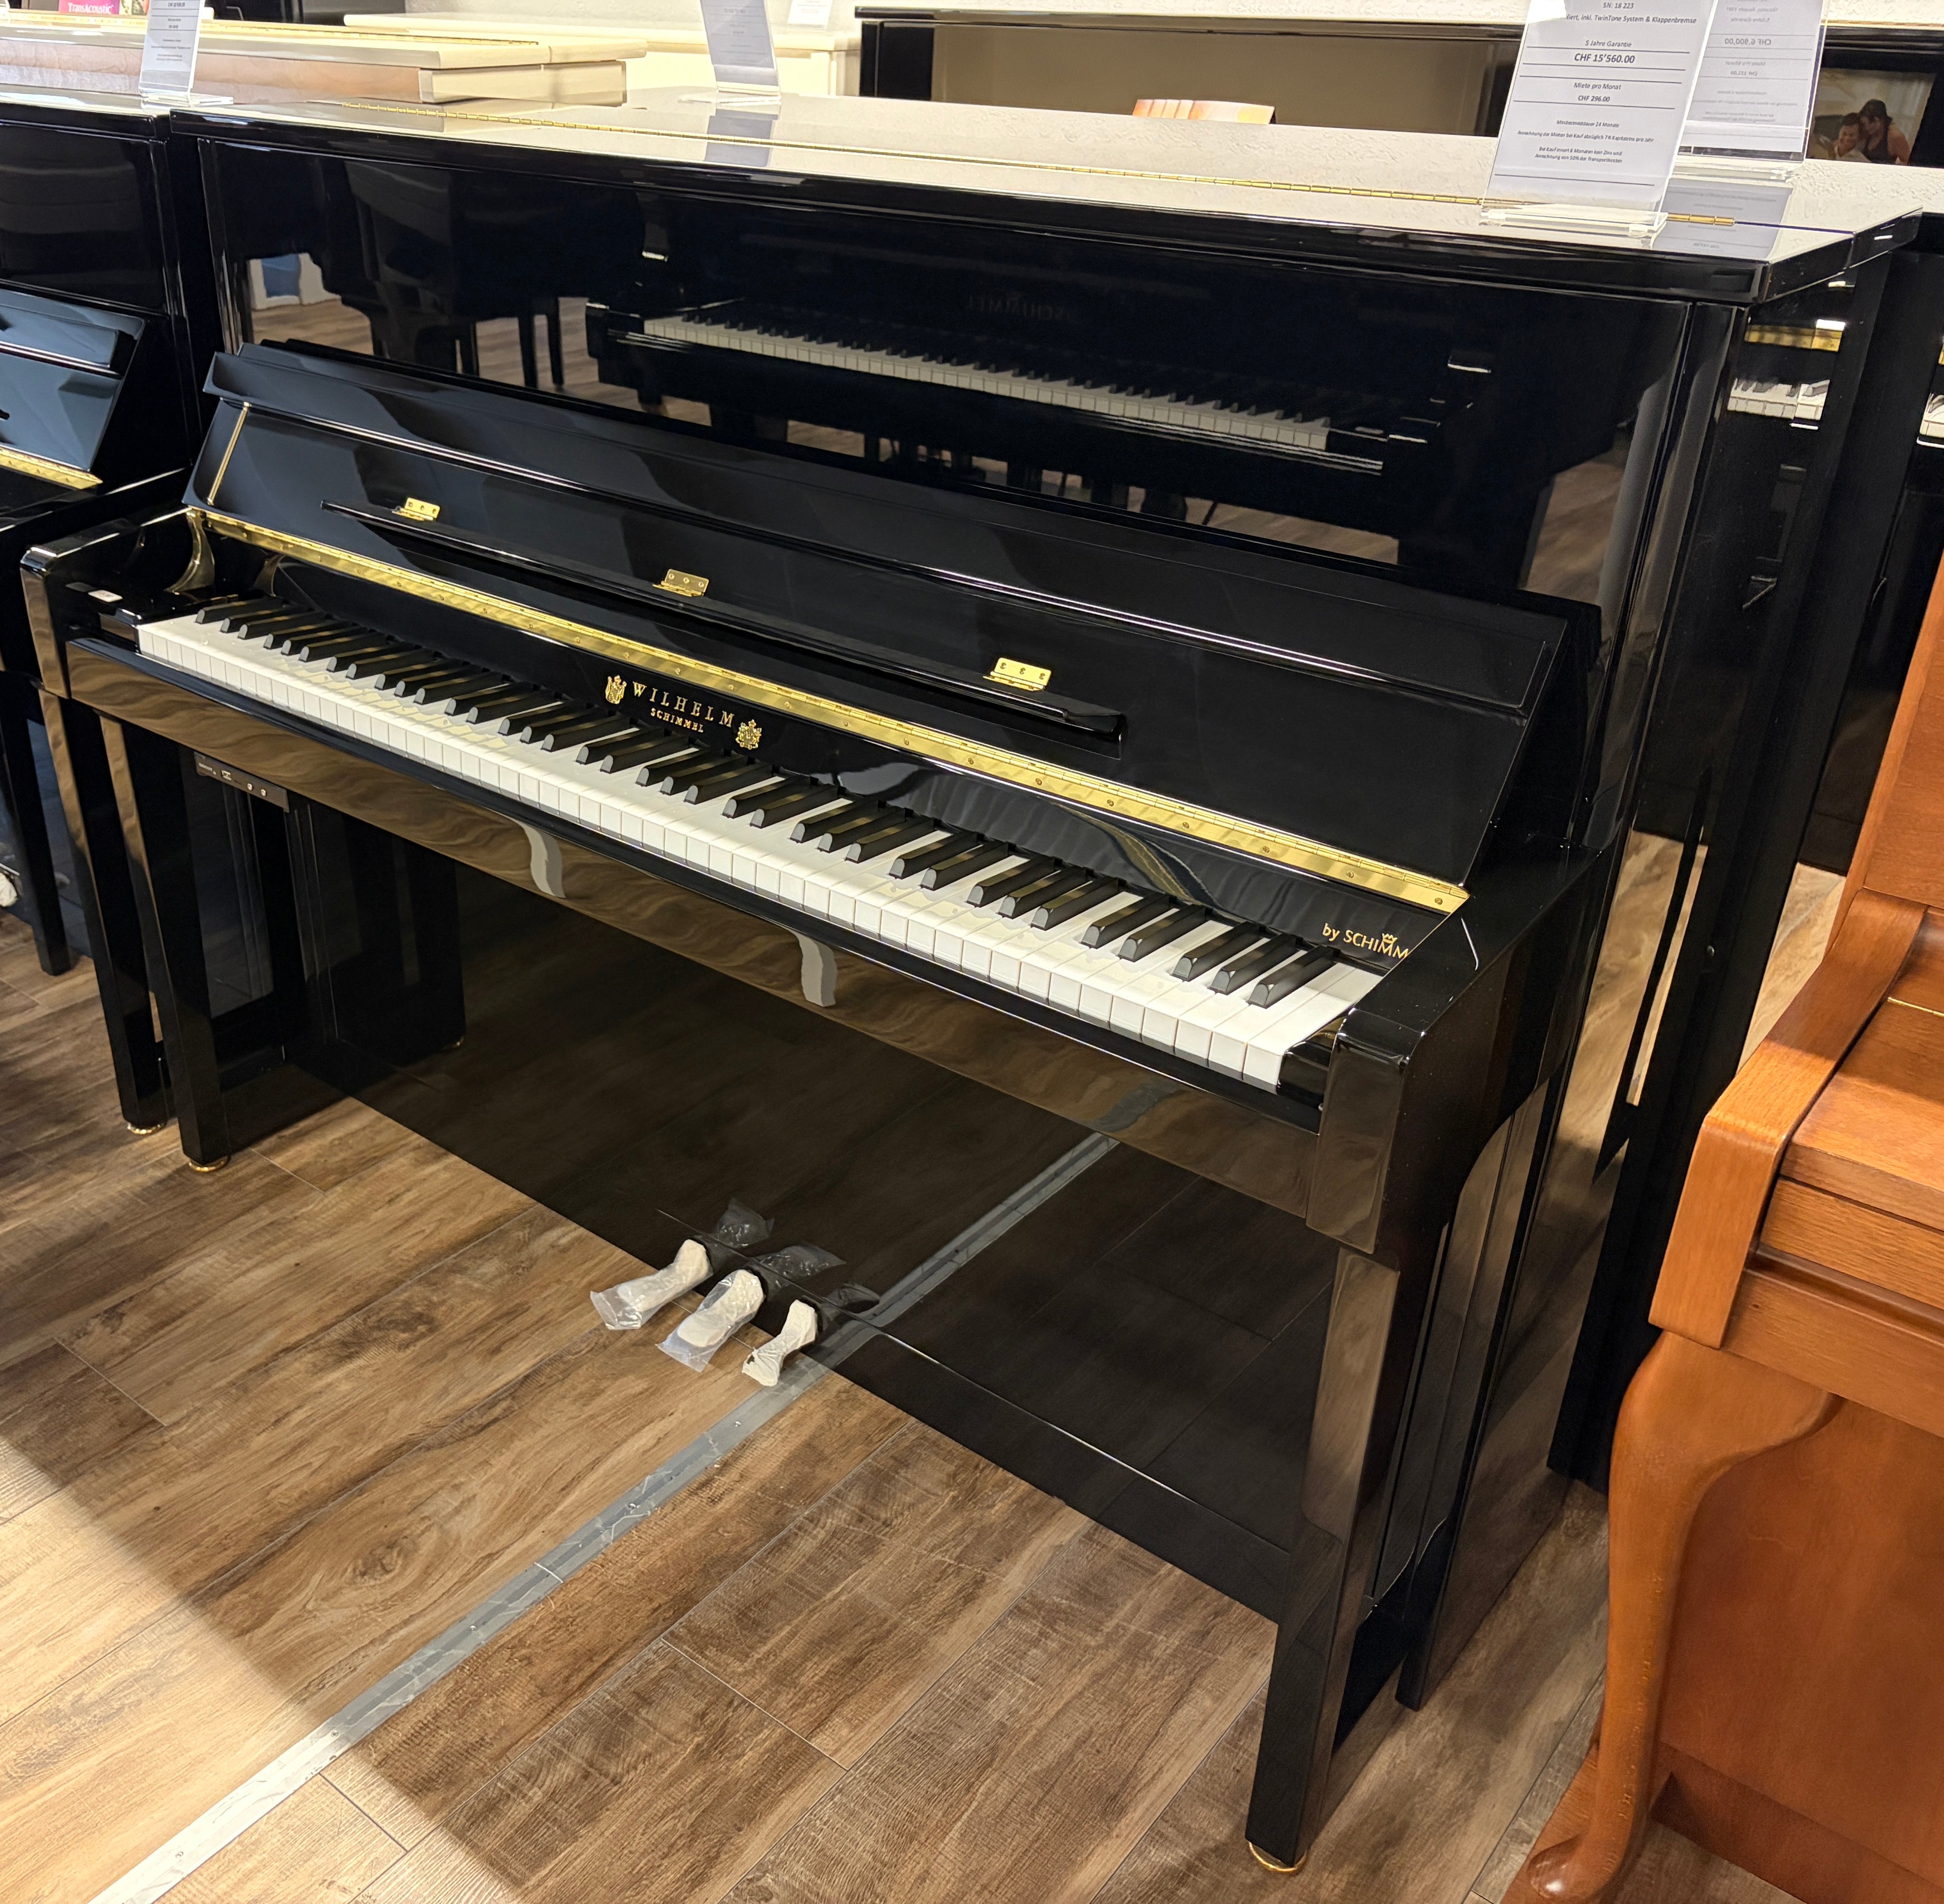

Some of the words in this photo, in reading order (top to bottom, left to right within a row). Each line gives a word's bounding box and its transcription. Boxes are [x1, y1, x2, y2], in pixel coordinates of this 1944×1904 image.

[68, 2, 114, 14] TransAcoustic
[1574, 53, 1592, 62] CHF
[632, 681, 735, 728] WILHELM
[650, 708, 704, 733] SCHIMMEL
[1322, 922, 1340, 942] by
